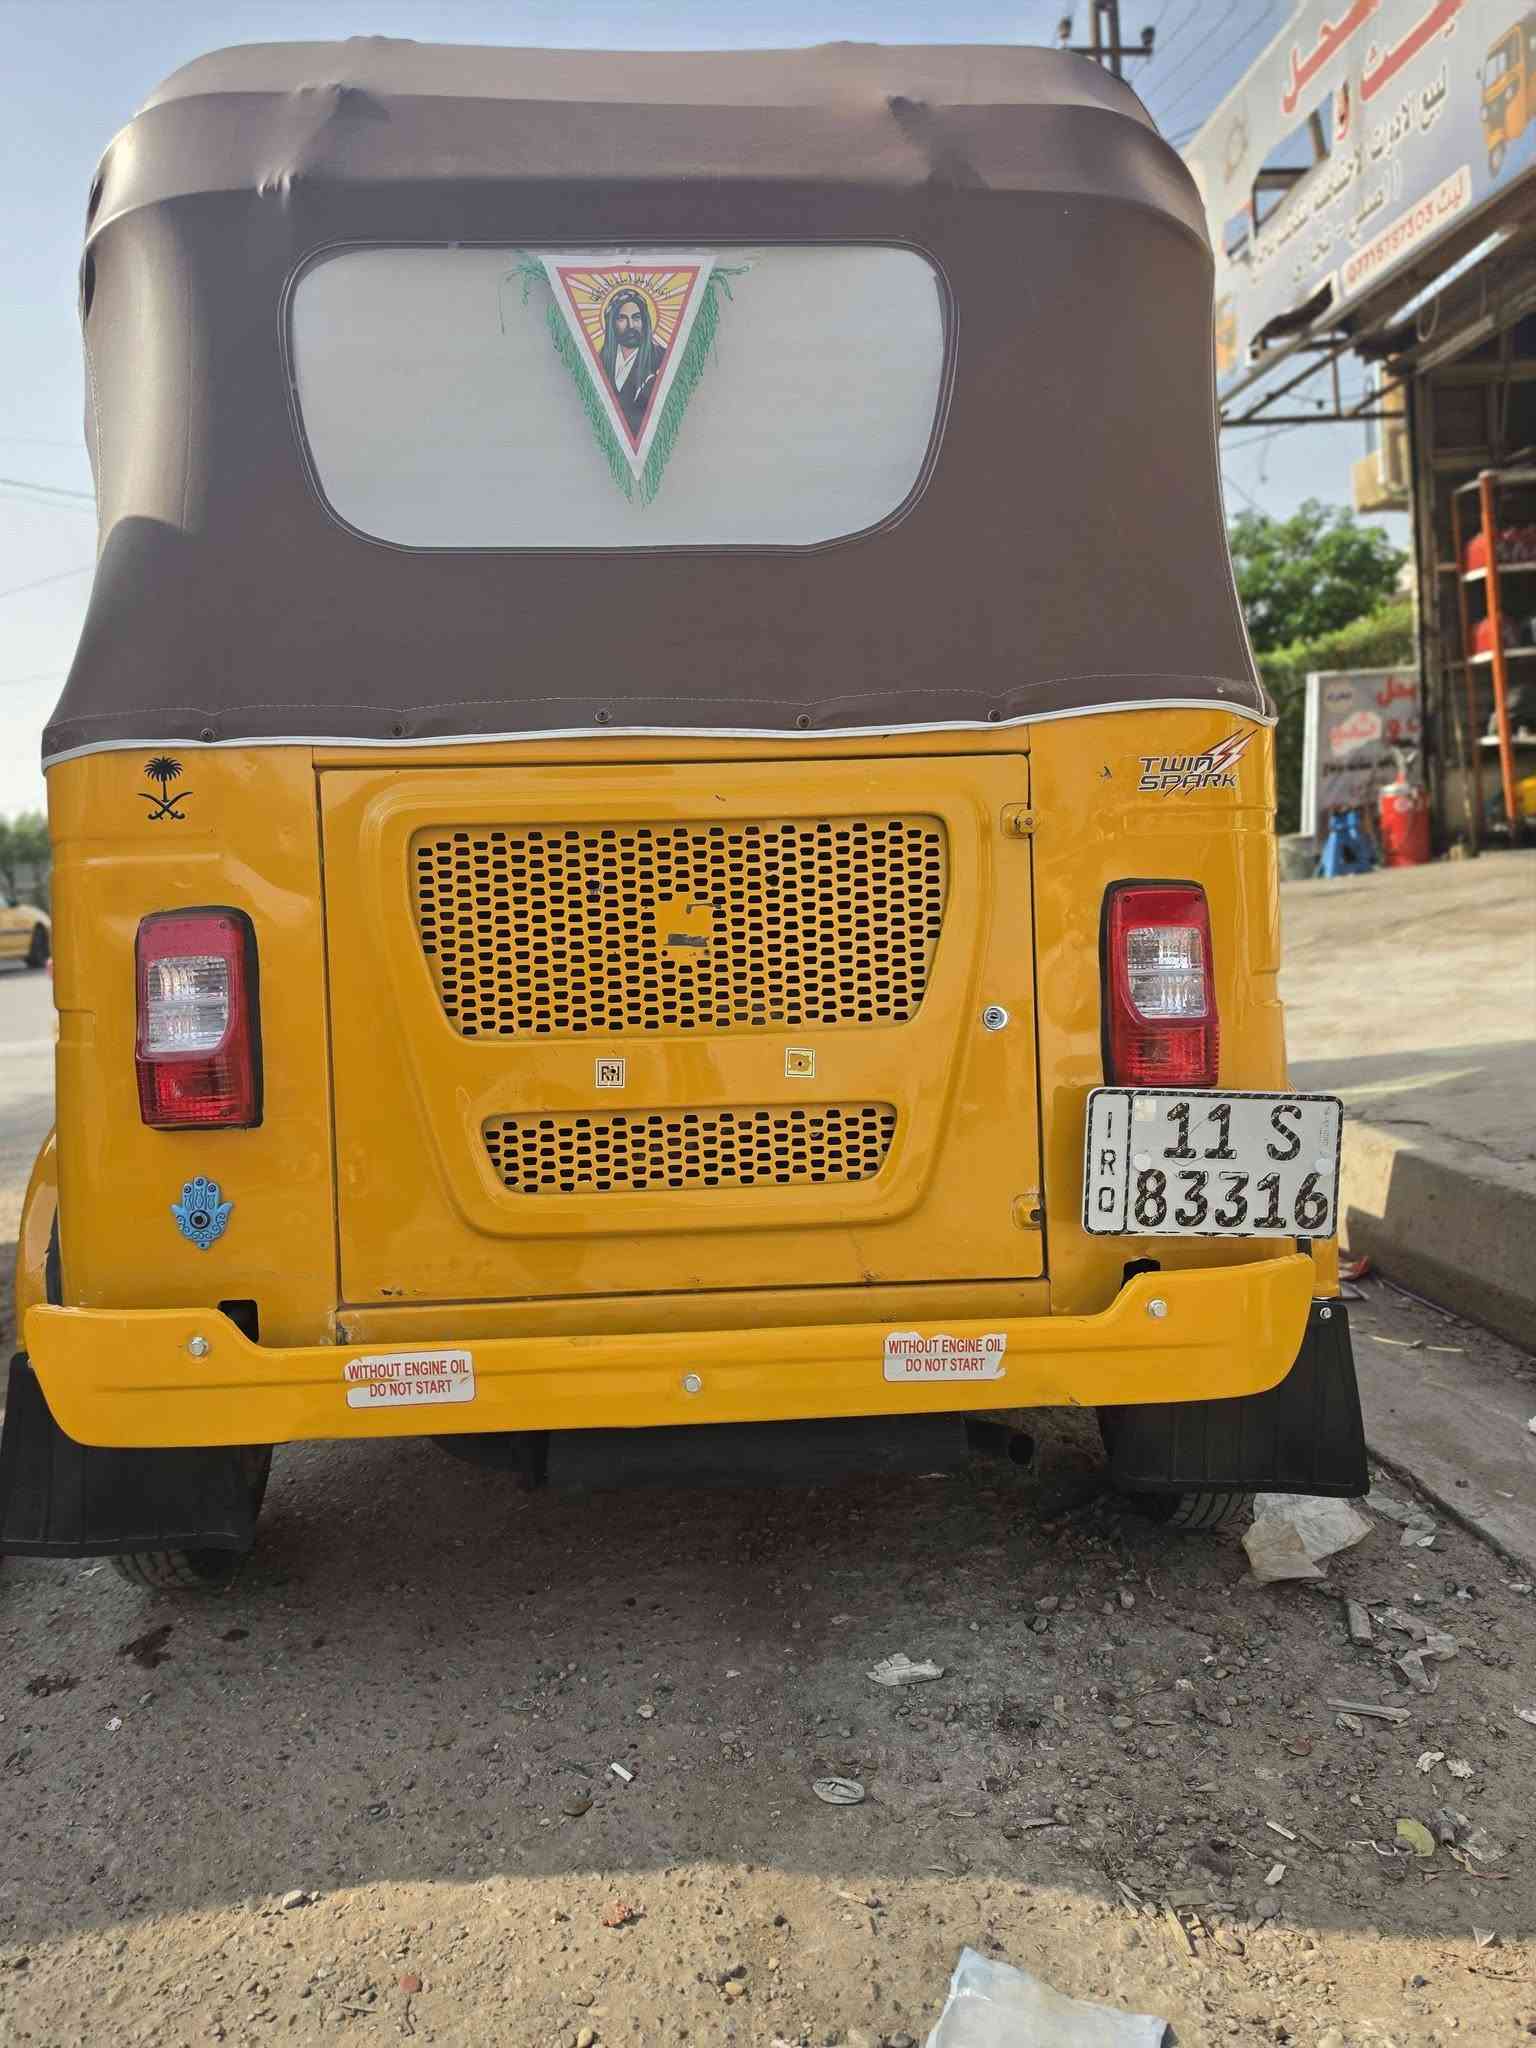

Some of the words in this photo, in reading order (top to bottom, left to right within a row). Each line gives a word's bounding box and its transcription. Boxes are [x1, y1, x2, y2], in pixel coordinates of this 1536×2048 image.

[1138, 755, 1214, 773] TWIN
[1138, 772, 1236, 792] SPARK
[1163, 1102, 1238, 1160] 11
[1266, 1103, 1303, 1161] S
[1134, 1168, 1329, 1230] 83316
[888, 1339, 940, 1354] WITHOUT
[942, 1338, 983, 1353] ENGINE
[985, 1338, 1004, 1352] OIL
[348, 1362, 402, 1380] WITHOUT
[404, 1360, 448, 1377] ENGINE
[450, 1359, 469, 1374] OIL
[905, 1358, 922, 1372] DO
[924, 1358, 948, 1372] NOT
[949, 1357, 986, 1372] START
[369, 1383, 387, 1398] DO
[389, 1382, 413, 1396] NOT
[415, 1379, 452, 1395] START
